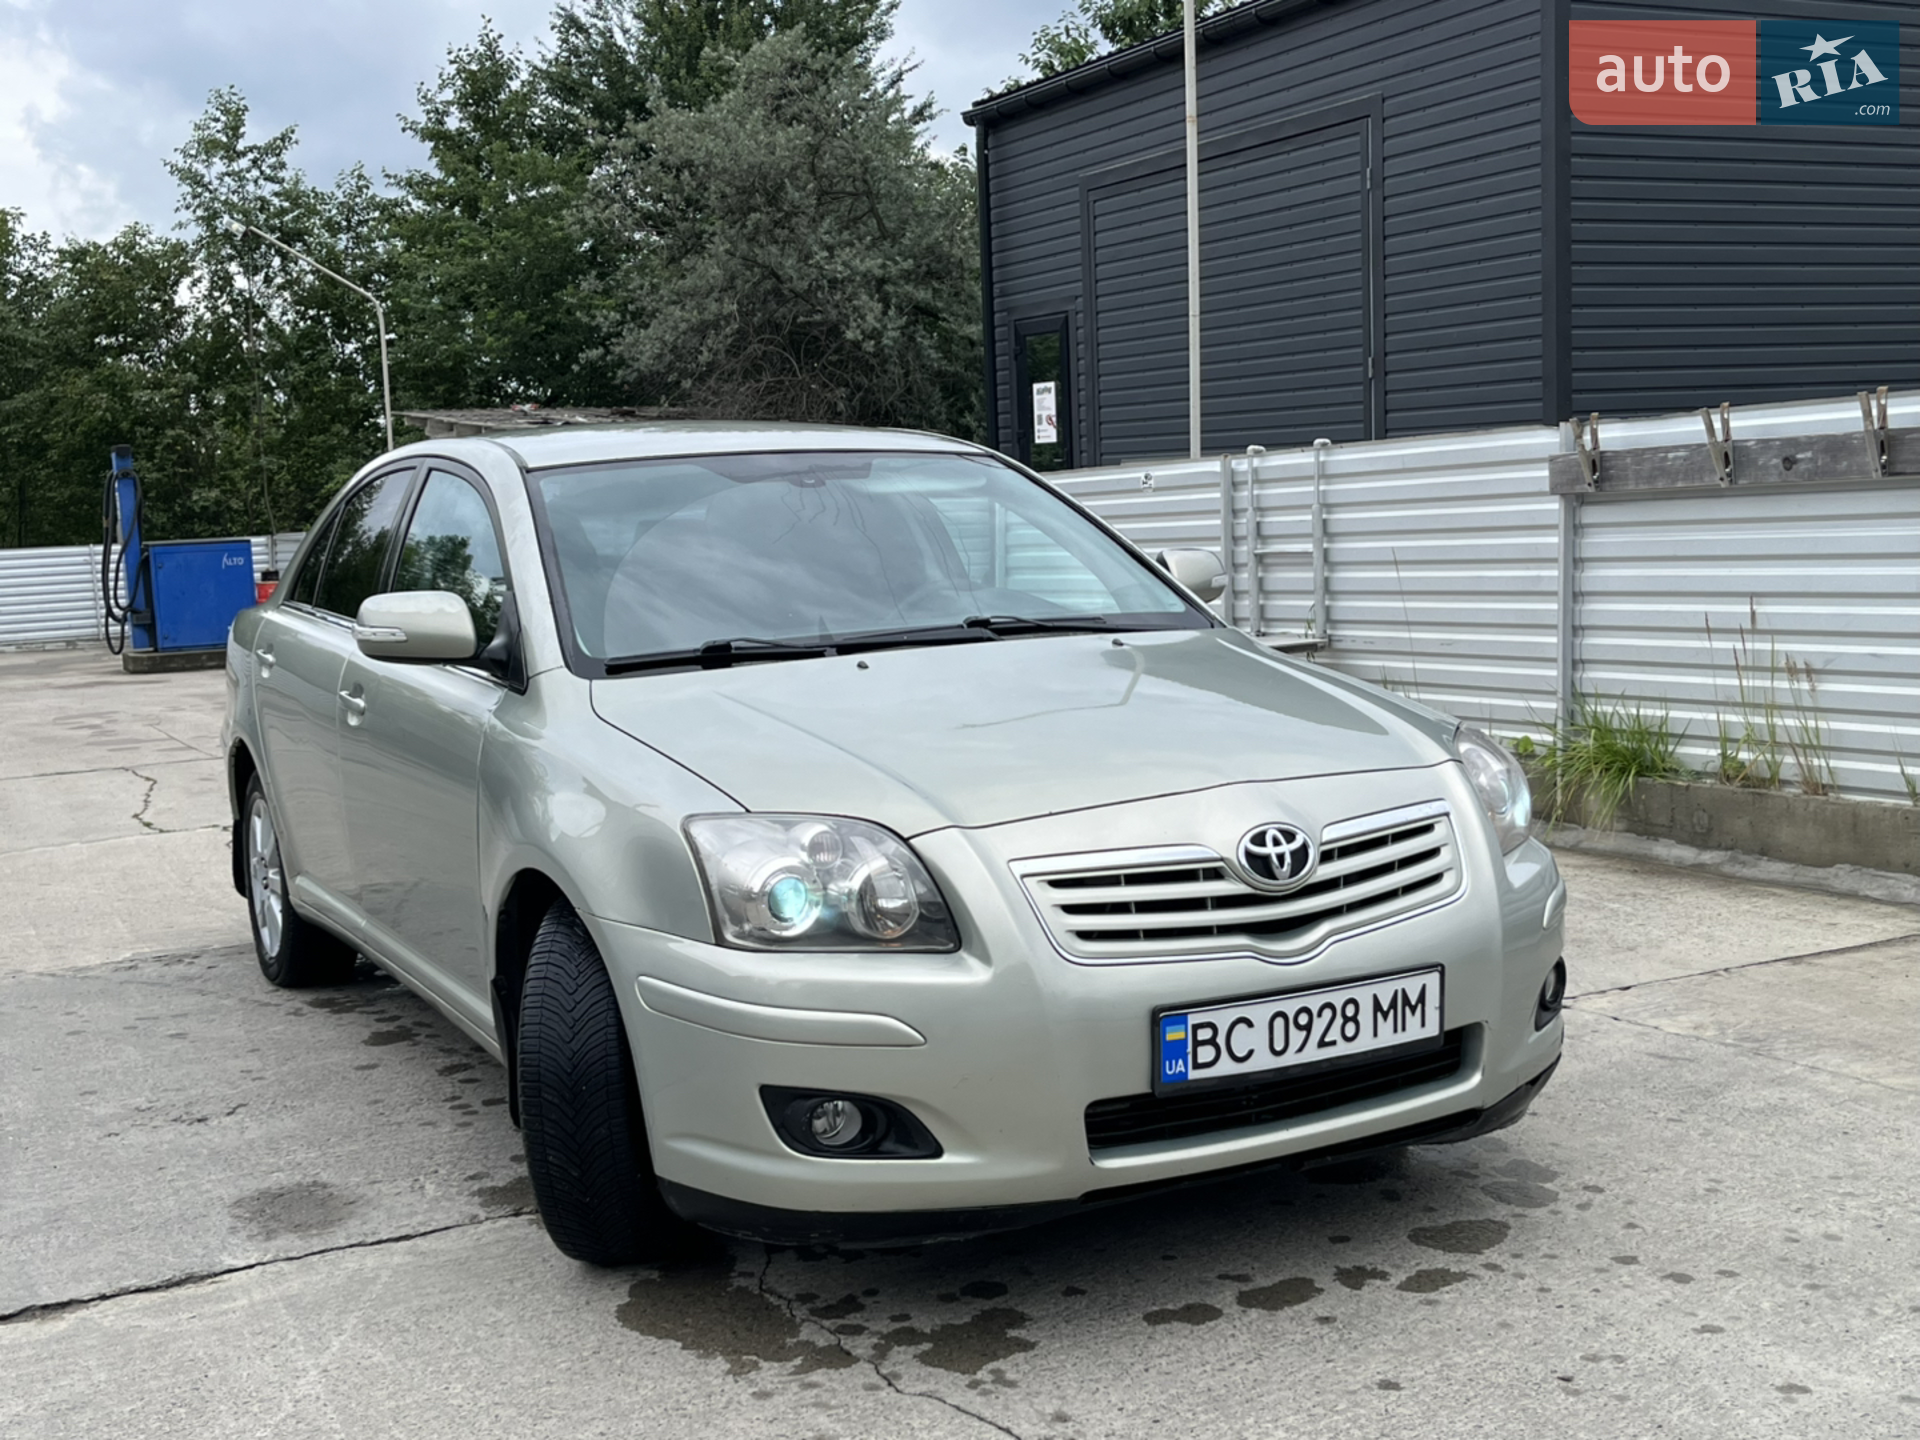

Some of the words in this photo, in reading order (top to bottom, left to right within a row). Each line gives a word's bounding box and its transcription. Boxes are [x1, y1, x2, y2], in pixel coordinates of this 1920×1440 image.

[1191, 1016, 1255, 1071] BC
[1268, 997, 1361, 1057] 0928
[1372, 983, 1426, 1038] MM
[1166, 1059, 1186, 1075] UA
